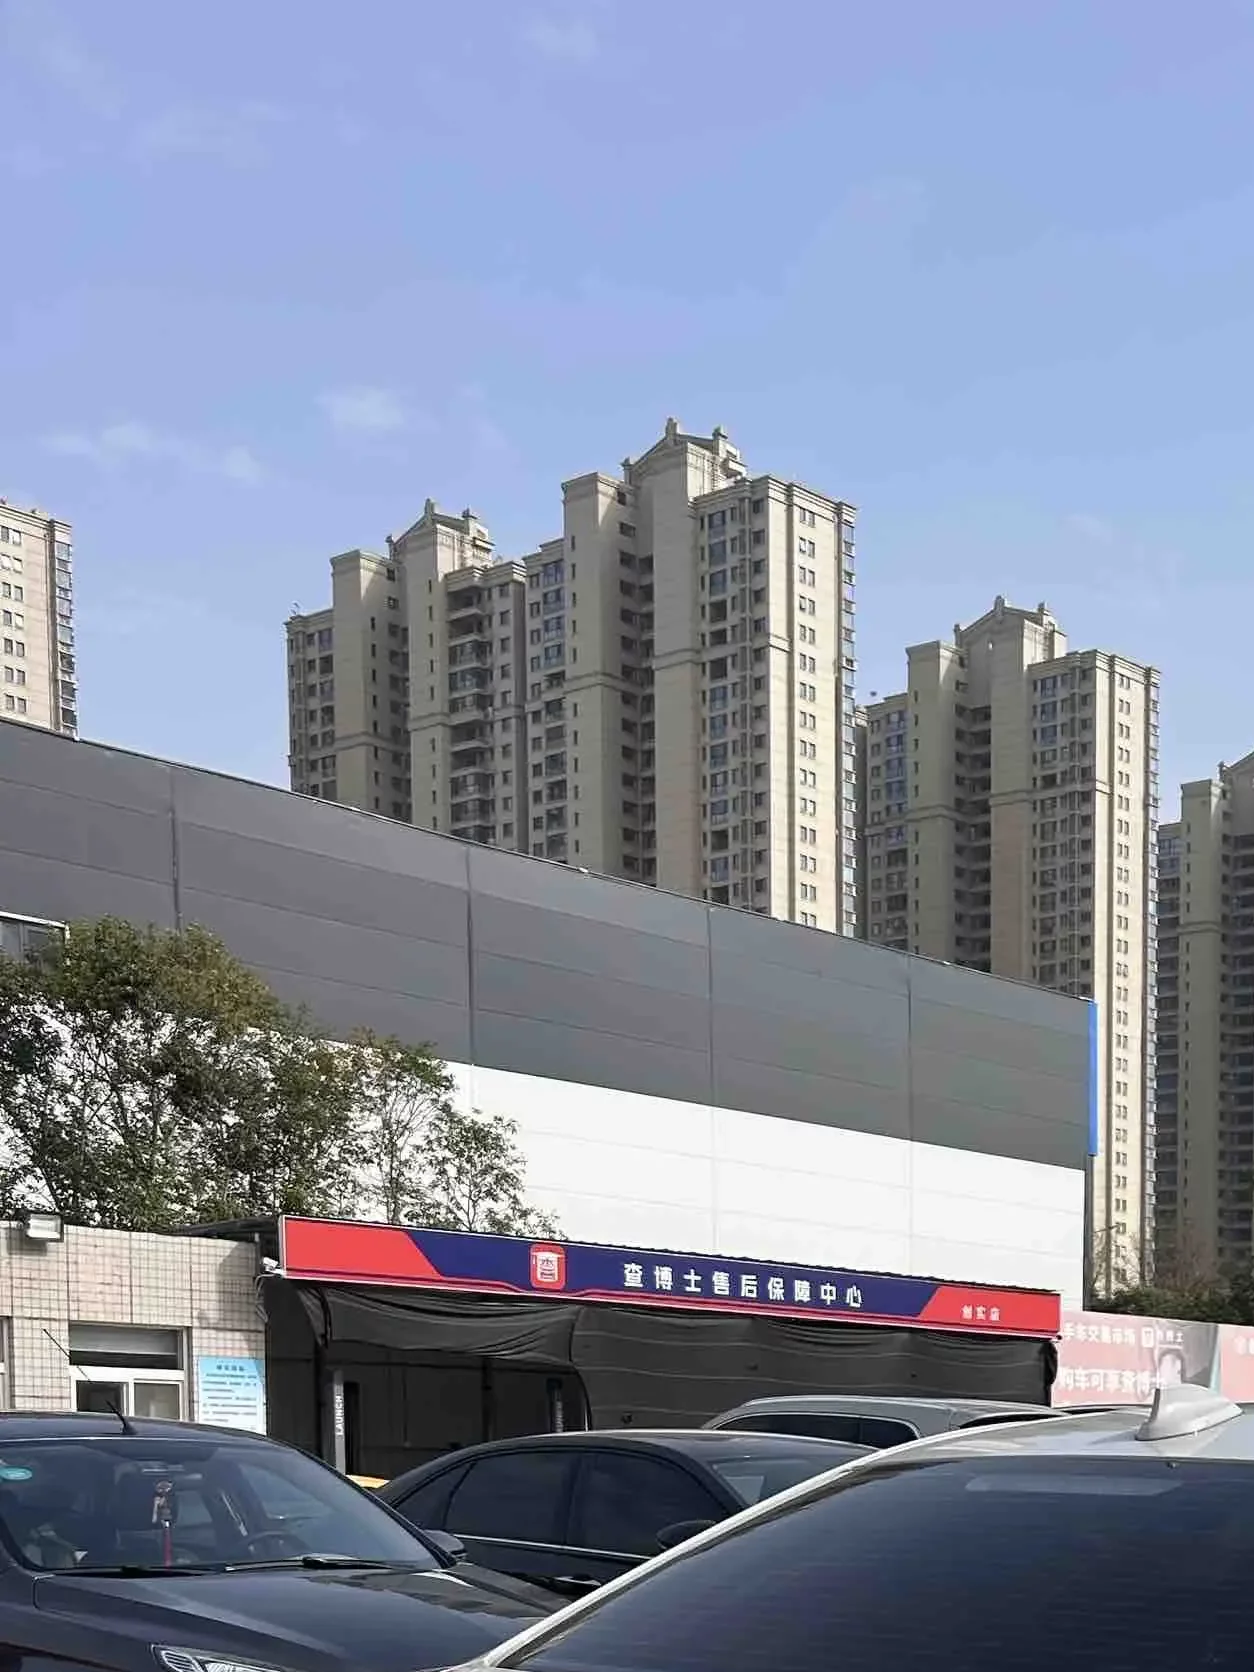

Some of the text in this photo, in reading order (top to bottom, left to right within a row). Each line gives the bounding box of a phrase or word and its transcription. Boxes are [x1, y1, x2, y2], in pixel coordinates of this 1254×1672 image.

[623, 1262, 863, 1308] 查博士售后保障中心
[335, 1395, 344, 1436] LAUNCH
